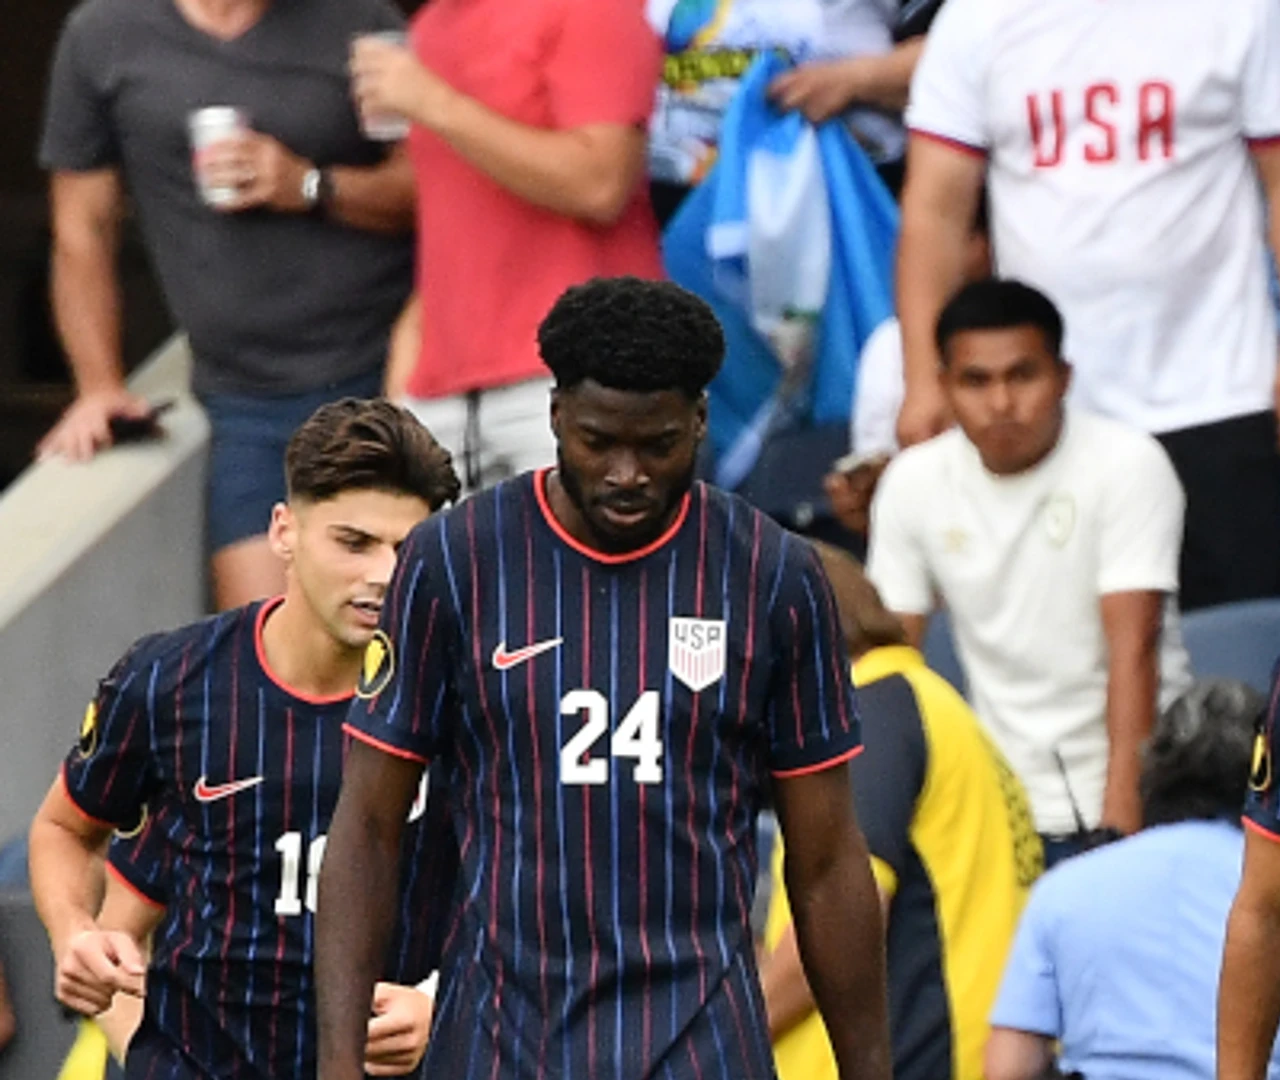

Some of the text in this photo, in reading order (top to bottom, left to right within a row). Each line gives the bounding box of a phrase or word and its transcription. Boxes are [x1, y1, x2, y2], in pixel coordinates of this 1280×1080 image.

[1026, 81, 1175, 167] USA
[674, 622, 722, 650] USA
[560, 690, 664, 784] 24
